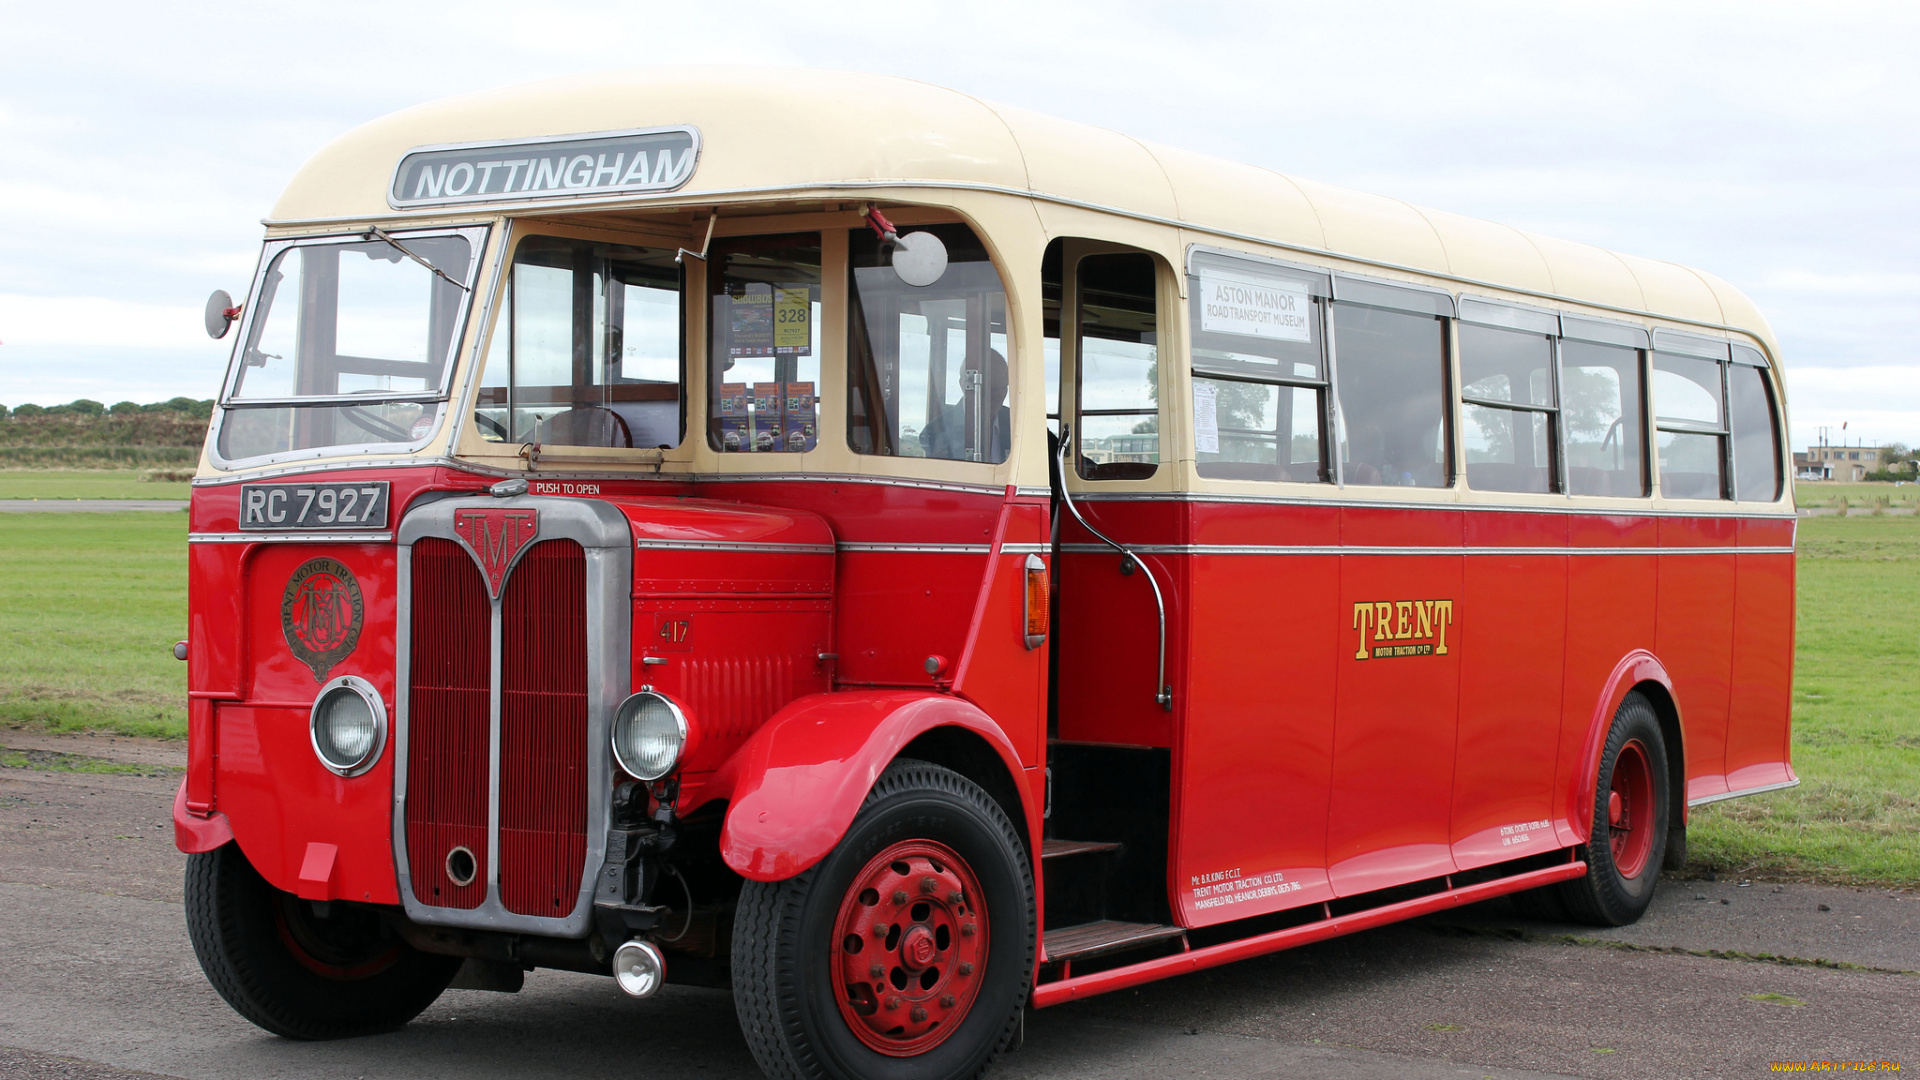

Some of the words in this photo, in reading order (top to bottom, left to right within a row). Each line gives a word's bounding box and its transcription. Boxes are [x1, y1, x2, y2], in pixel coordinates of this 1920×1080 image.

[414, 147, 690, 198] NOTTINGHAM
[1216, 285, 1252, 304] ASTON
[1255, 291, 1296, 312] MANOR
[778, 309, 806, 323] 328
[1207, 304, 1229, 319] ROAD
[1229, 307, 1271, 324] TRANSPORT
[1273, 314, 1305, 328] MUSEUM
[536, 482, 560, 494] PUSH
[562, 483, 574, 494] TO
[576, 484, 600, 495] OPEN
[246, 488, 287, 523] RC
[296, 487, 381, 522] 7927
[461, 513, 530, 570] TMT
[283, 588, 295, 634] TRENT
[292, 560, 330, 587] MOTOR
[334, 563, 362, 623] TRACTION
[659, 621, 689, 643] 417
[1353, 599, 1453, 660] TRENT
[1375, 647, 1393, 657] MOTOR
[1394, 645, 1417, 655] TRACTION
[1193, 886, 1212, 899] TRENT
[1213, 882, 1234, 896] MOTOR
[1234, 877, 1263, 891] TRACTION
[1194, 896, 1226, 910] MANSFIELD
